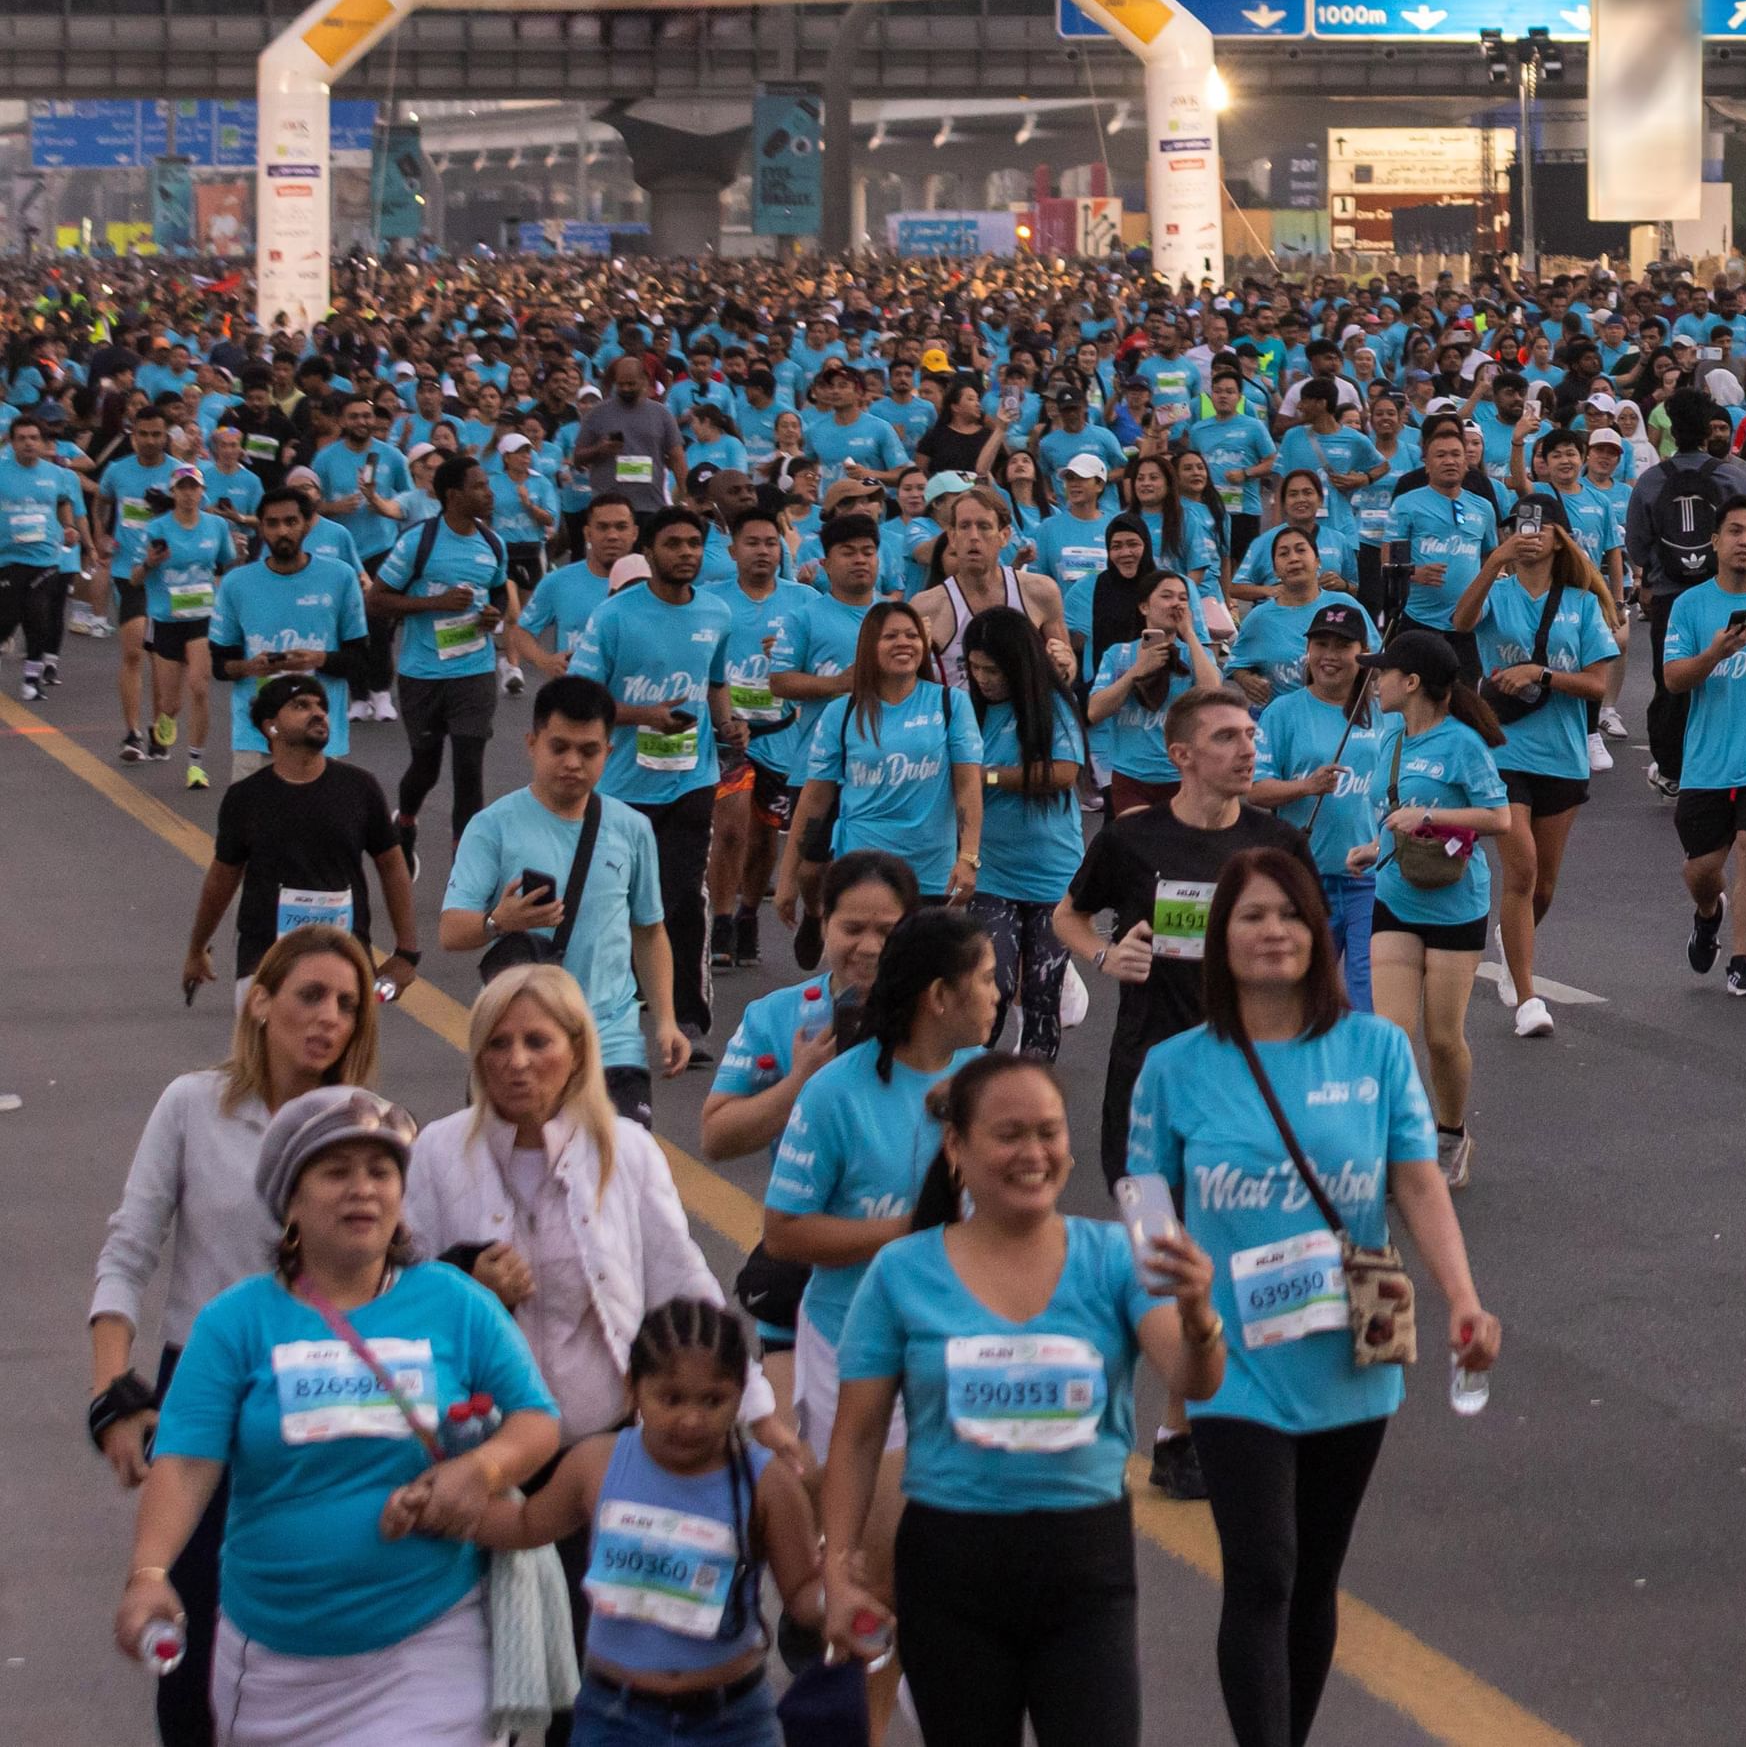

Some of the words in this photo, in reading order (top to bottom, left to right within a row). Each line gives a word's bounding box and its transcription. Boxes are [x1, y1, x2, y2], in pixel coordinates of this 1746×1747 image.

[1318, 5, 1387, 26] 1000m
[623, 675, 669, 703] Mai
[1175, 888, 1201, 899] RUN
[1165, 912, 1207, 929] 1191
[1194, 1162, 1272, 1212] Mai
